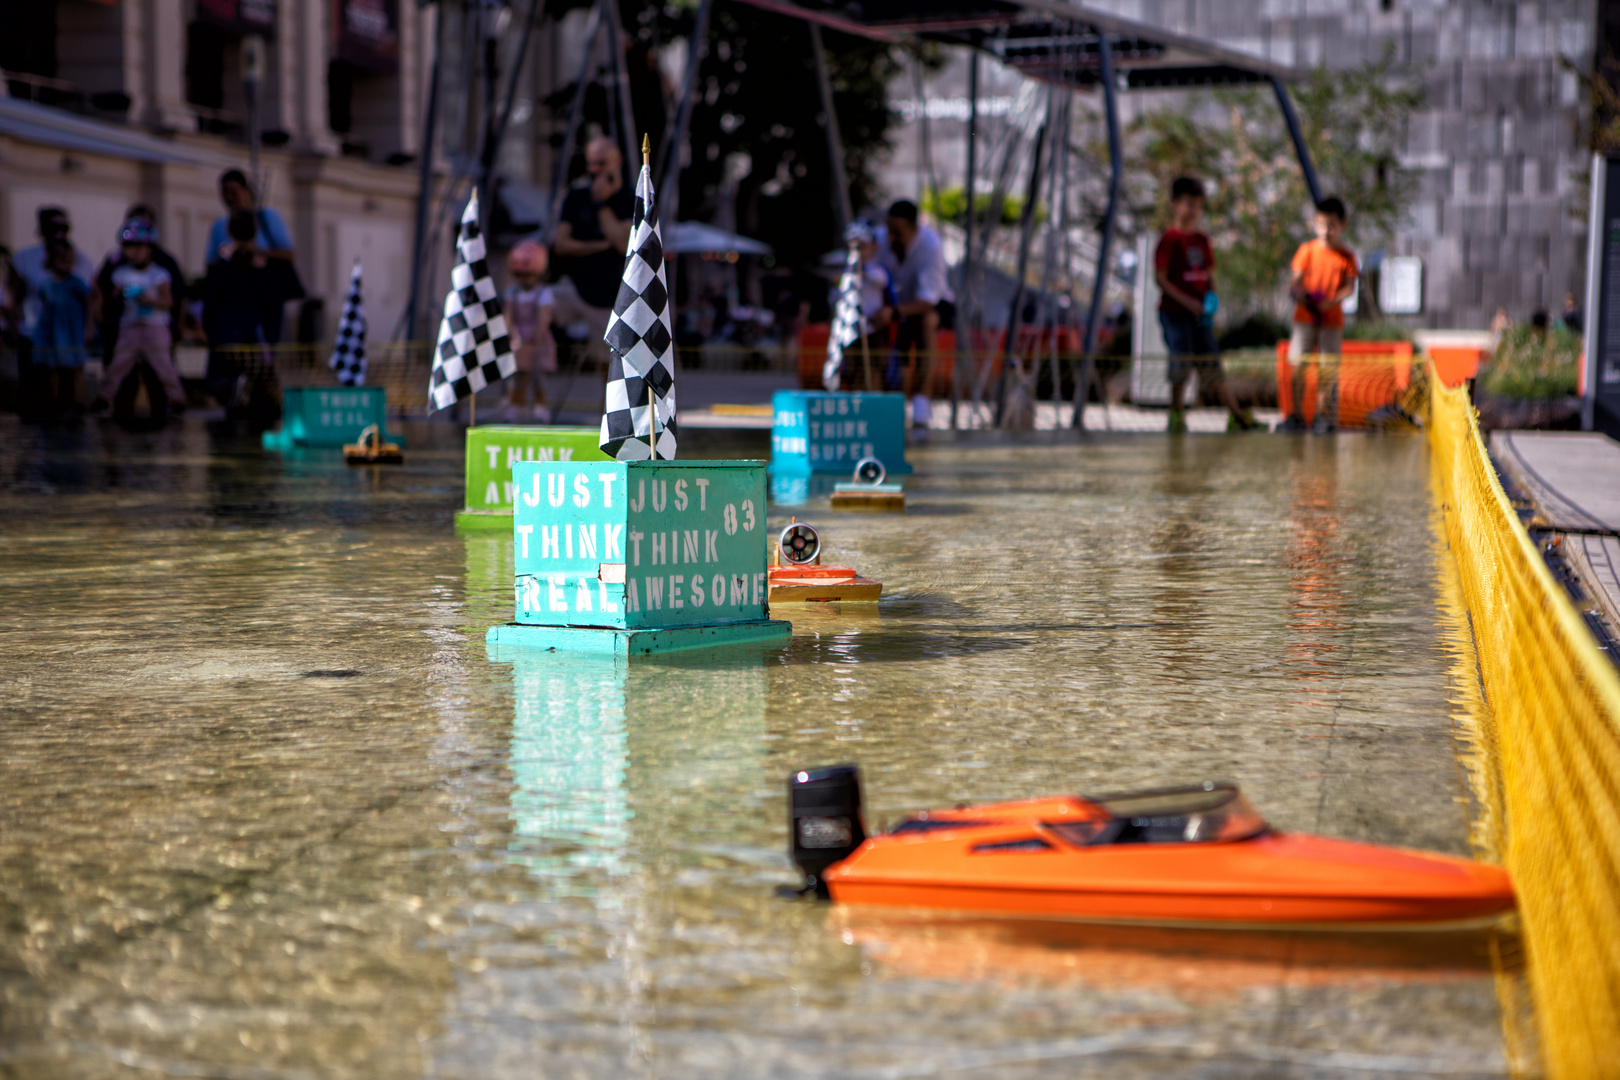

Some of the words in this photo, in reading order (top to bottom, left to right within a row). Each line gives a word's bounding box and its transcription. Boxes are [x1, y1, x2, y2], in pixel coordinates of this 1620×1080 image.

[810, 398, 862, 415] JUST
[810, 421, 868, 439] THINK
[523, 473, 617, 508] JUST
[630, 478, 710, 513] JUST
[723, 499, 756, 536] 83
[517, 523, 623, 560] THINK
[629, 529, 719, 566] THINK
[521, 573, 619, 613] REAL
[627, 572, 765, 613] AWESOME
